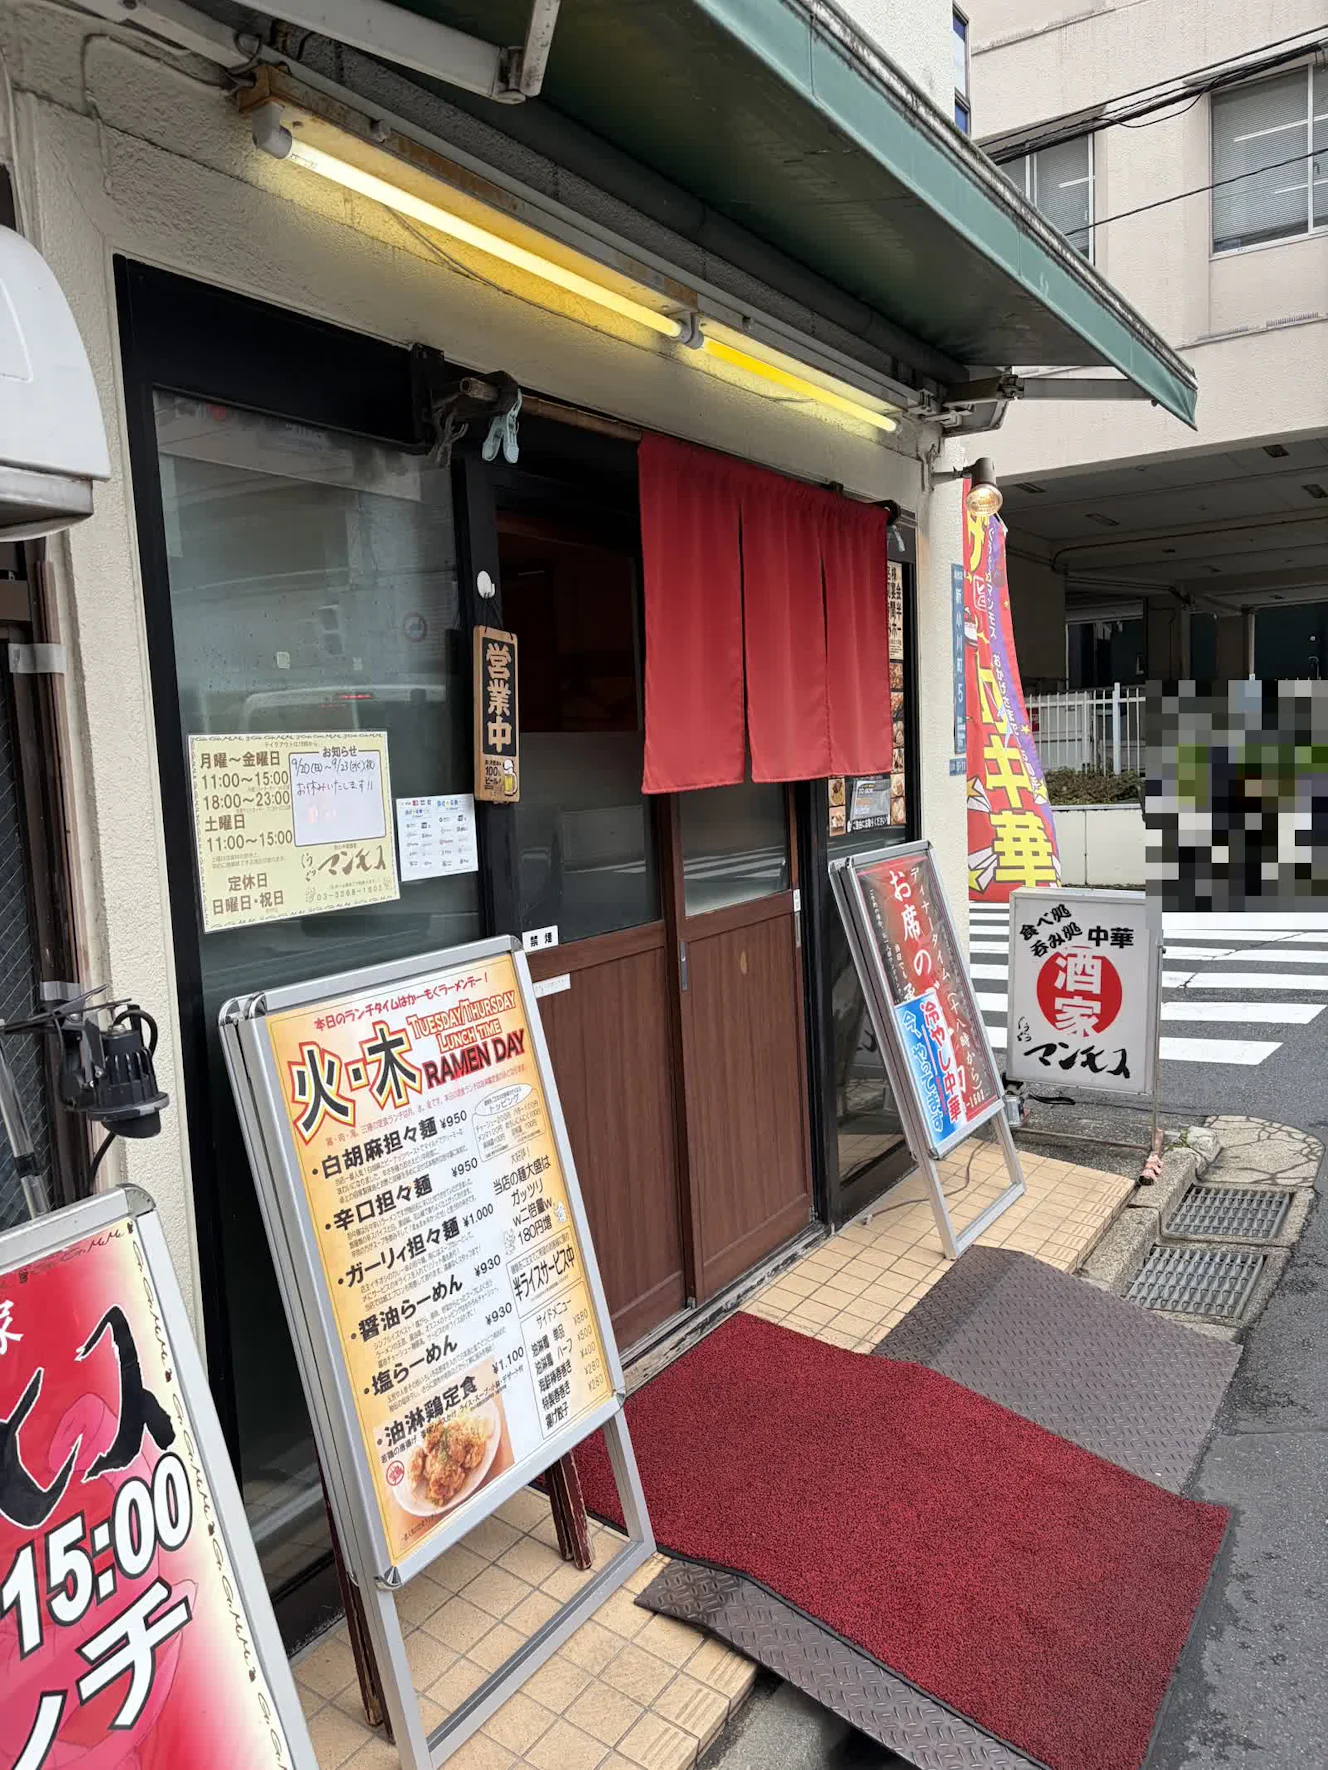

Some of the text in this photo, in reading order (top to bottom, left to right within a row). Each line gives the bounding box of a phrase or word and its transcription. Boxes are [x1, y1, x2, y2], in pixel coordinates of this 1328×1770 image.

[486, 643, 512, 753] 営業中
[322, 746, 358, 758] お知らせ
[205, 815, 246, 832] 土曜日
[318, 845, 386, 876] マンモス
[228, 872, 268, 892] 定休日
[212, 890, 285, 915] 日曜日・祝日
[1019, 904, 1071, 941] 食べ処
[1030, 922, 1083, 958] 呑み処
[1088, 925, 1134, 949] 中華
[1054, 946, 1102, 1038] 酒家
[422, 1028, 526, 1089] RAMEN DAY
[919, 999, 962, 1124] 冷やし中華
[1023, 1042, 1131, 1079] マンモス
[288, 1020, 422, 1146] 火・木
[488, 1094, 520, 1113] トッピング
[321, 1116, 439, 1180] 白胡麻担々麺
[439, 1109, 468, 1130] ¥950
[333, 1174, 433, 1232] 辛口担々麺
[451, 1156, 479, 1179] ¥950
[492, 1155, 552, 1197] 当店の麺大盛は
[511, 1178, 544, 1208] ガッツリ
[517, 1215, 553, 1245] 180円増
[512, 1246, 575, 1302] 半ライスサービス中
[358, 1274, 463, 1342] 醤油らーめん
[474, 1255, 502, 1278] ¥930
[535, 1299, 573, 1330] サイドメニュー
[371, 1335, 458, 1396] 塩らーめん
[484, 1304, 513, 1327] ¥930
[557, 1338, 574, 1360] ハーフ
[384, 1375, 478, 1447] 油淋鶏定食
[2, 1452, 193, 1659] 15:00
